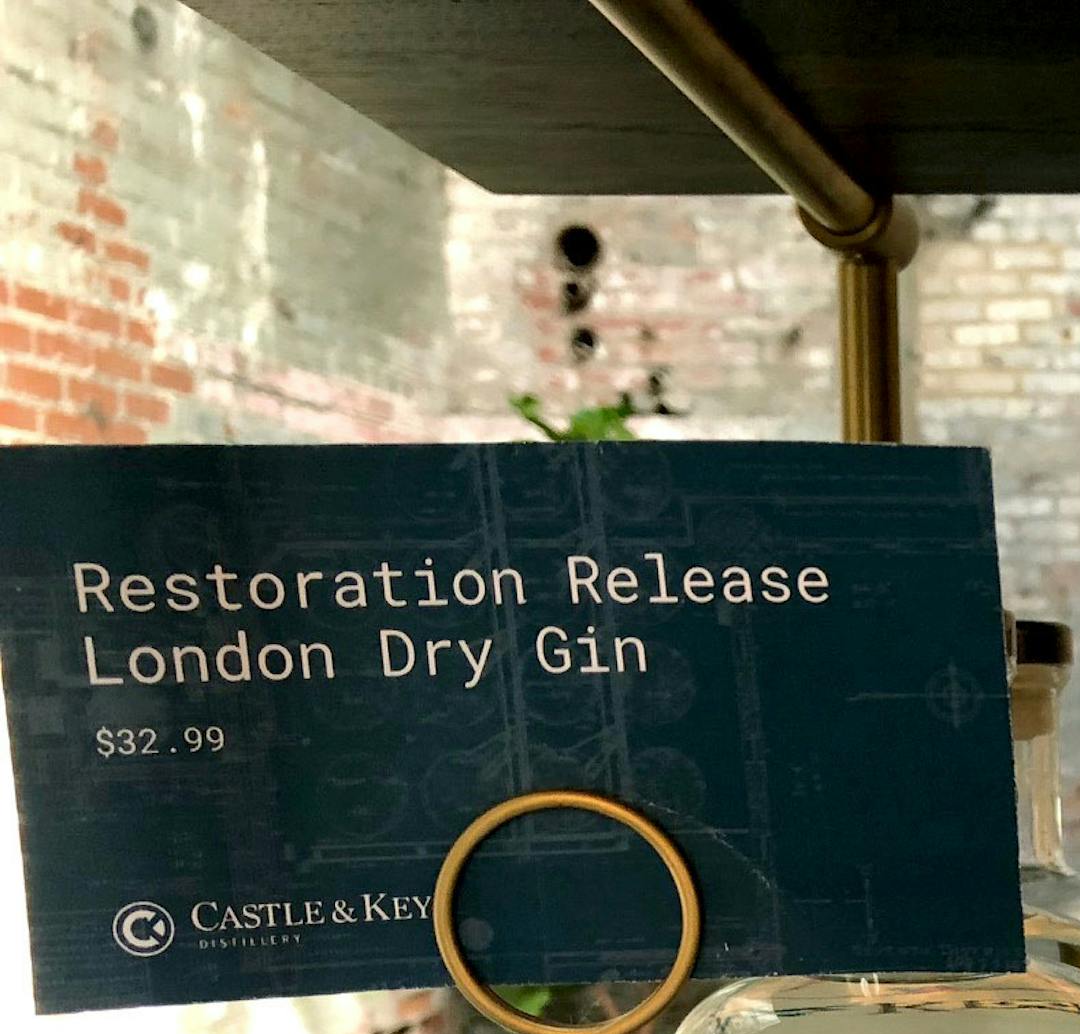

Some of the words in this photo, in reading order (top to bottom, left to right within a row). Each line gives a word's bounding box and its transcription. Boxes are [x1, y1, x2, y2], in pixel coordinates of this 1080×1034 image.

[73, 557, 527, 613] Restoration
[567, 552, 830, 605] Release
[83, 630, 336, 686] London
[379, 629, 493, 689] Dry
[535, 625, 648, 674] Gin
[95, 726, 225, 758] $32.99
[190, 900, 326, 932] CASTLE
[331, 899, 358, 923] &
[361, 892, 434, 922] KEY
[199, 935, 302, 950] DISTILLERY
